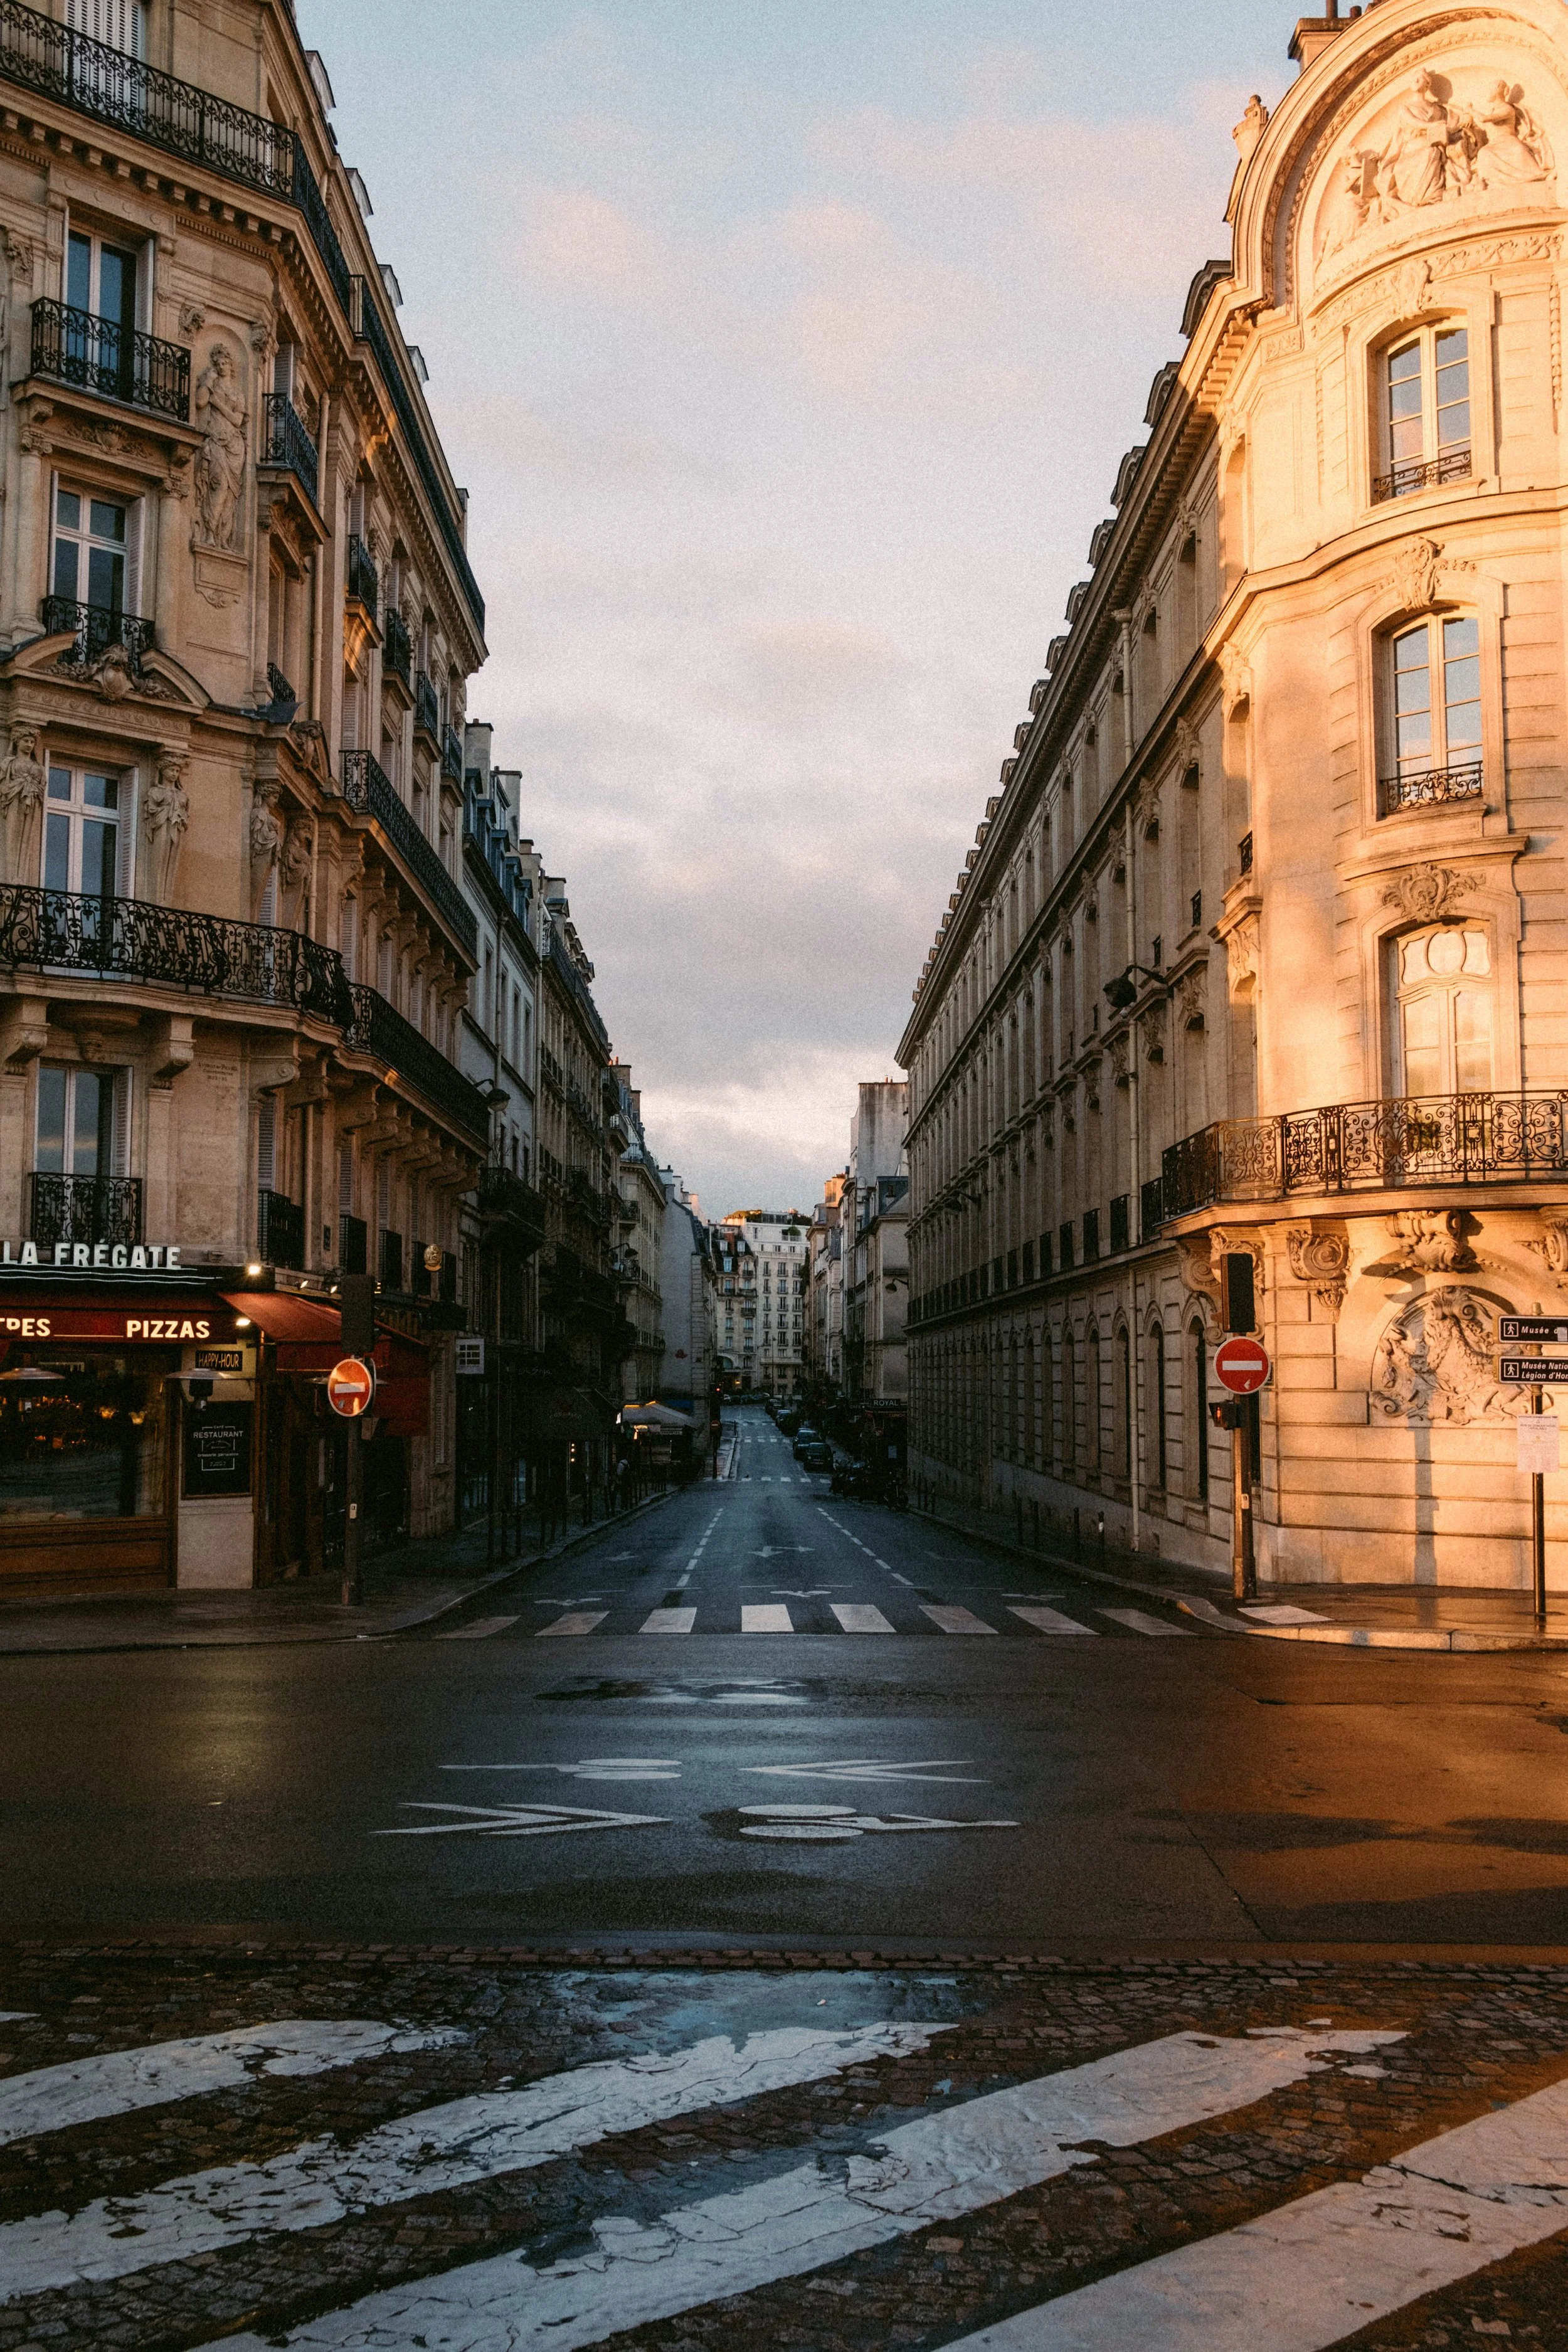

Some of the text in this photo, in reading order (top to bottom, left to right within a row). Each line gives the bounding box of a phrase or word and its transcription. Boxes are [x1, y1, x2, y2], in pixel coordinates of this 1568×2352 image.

[3, 1239, 182, 1270] LA FRÉGATE
[127, 1320, 210, 1338] PIZZAS
[1521, 1326, 1549, 1334] Musée
[198, 1353, 240, 1368] HAPPY-HOUR
[1521, 1362, 1546, 1370] Musée
[1522, 1371, 1546, 1380] Légion
